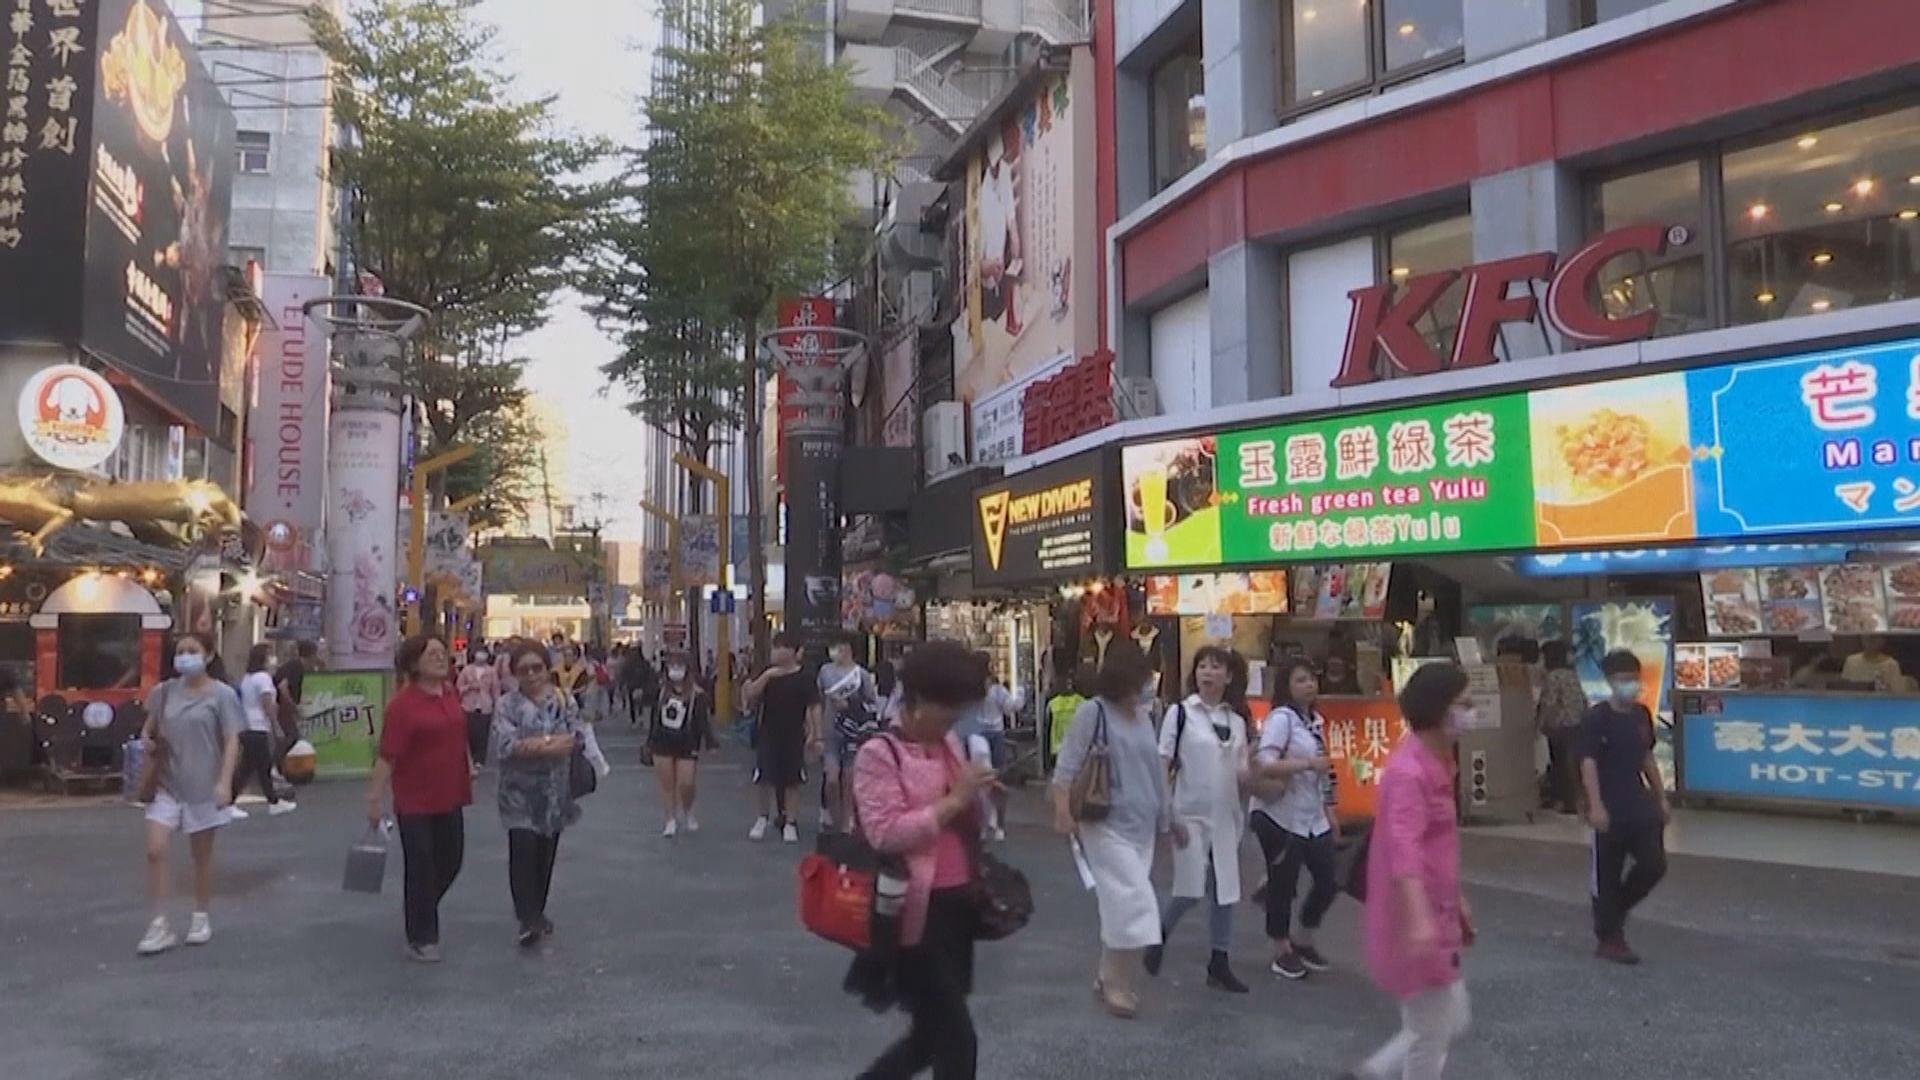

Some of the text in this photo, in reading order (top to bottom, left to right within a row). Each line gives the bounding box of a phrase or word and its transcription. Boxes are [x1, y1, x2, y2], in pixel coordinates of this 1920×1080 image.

[1330, 223, 1667, 388] KFC
[278, 306, 305, 497] ETUDE HOUSE
[1009, 480, 1091, 524] NEW DIVIDE
[1248, 477, 1487, 517] Fresh green tea Yulu
[1329, 717, 1410, 760] 鮮果
[1751, 763, 1920, 791] HOT-ST
